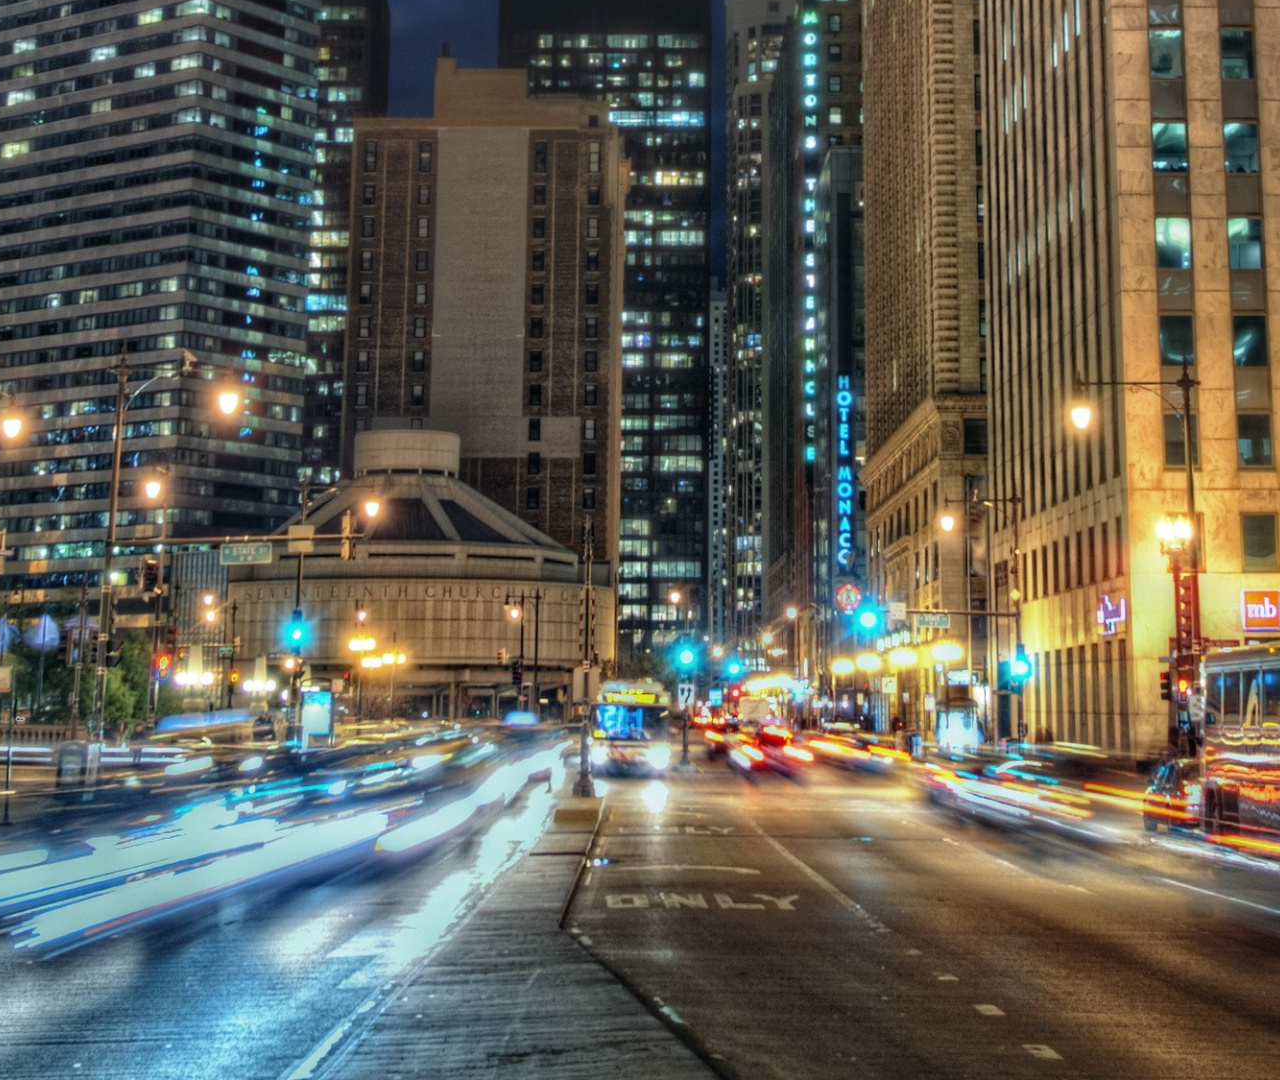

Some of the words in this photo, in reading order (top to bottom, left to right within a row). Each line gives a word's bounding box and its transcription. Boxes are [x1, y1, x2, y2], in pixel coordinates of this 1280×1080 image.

[805, 177, 817, 233] THE
[837, 375, 852, 456] HOTEL
[232, 546, 256, 556] STATE
[245, 584, 409, 601] SEVENTEENTH
[425, 586, 515, 600] CHURCH
[529, 588, 550, 601] OF
[1246, 597, 1277, 618] mb
[605, 892, 799, 910] ONLY
